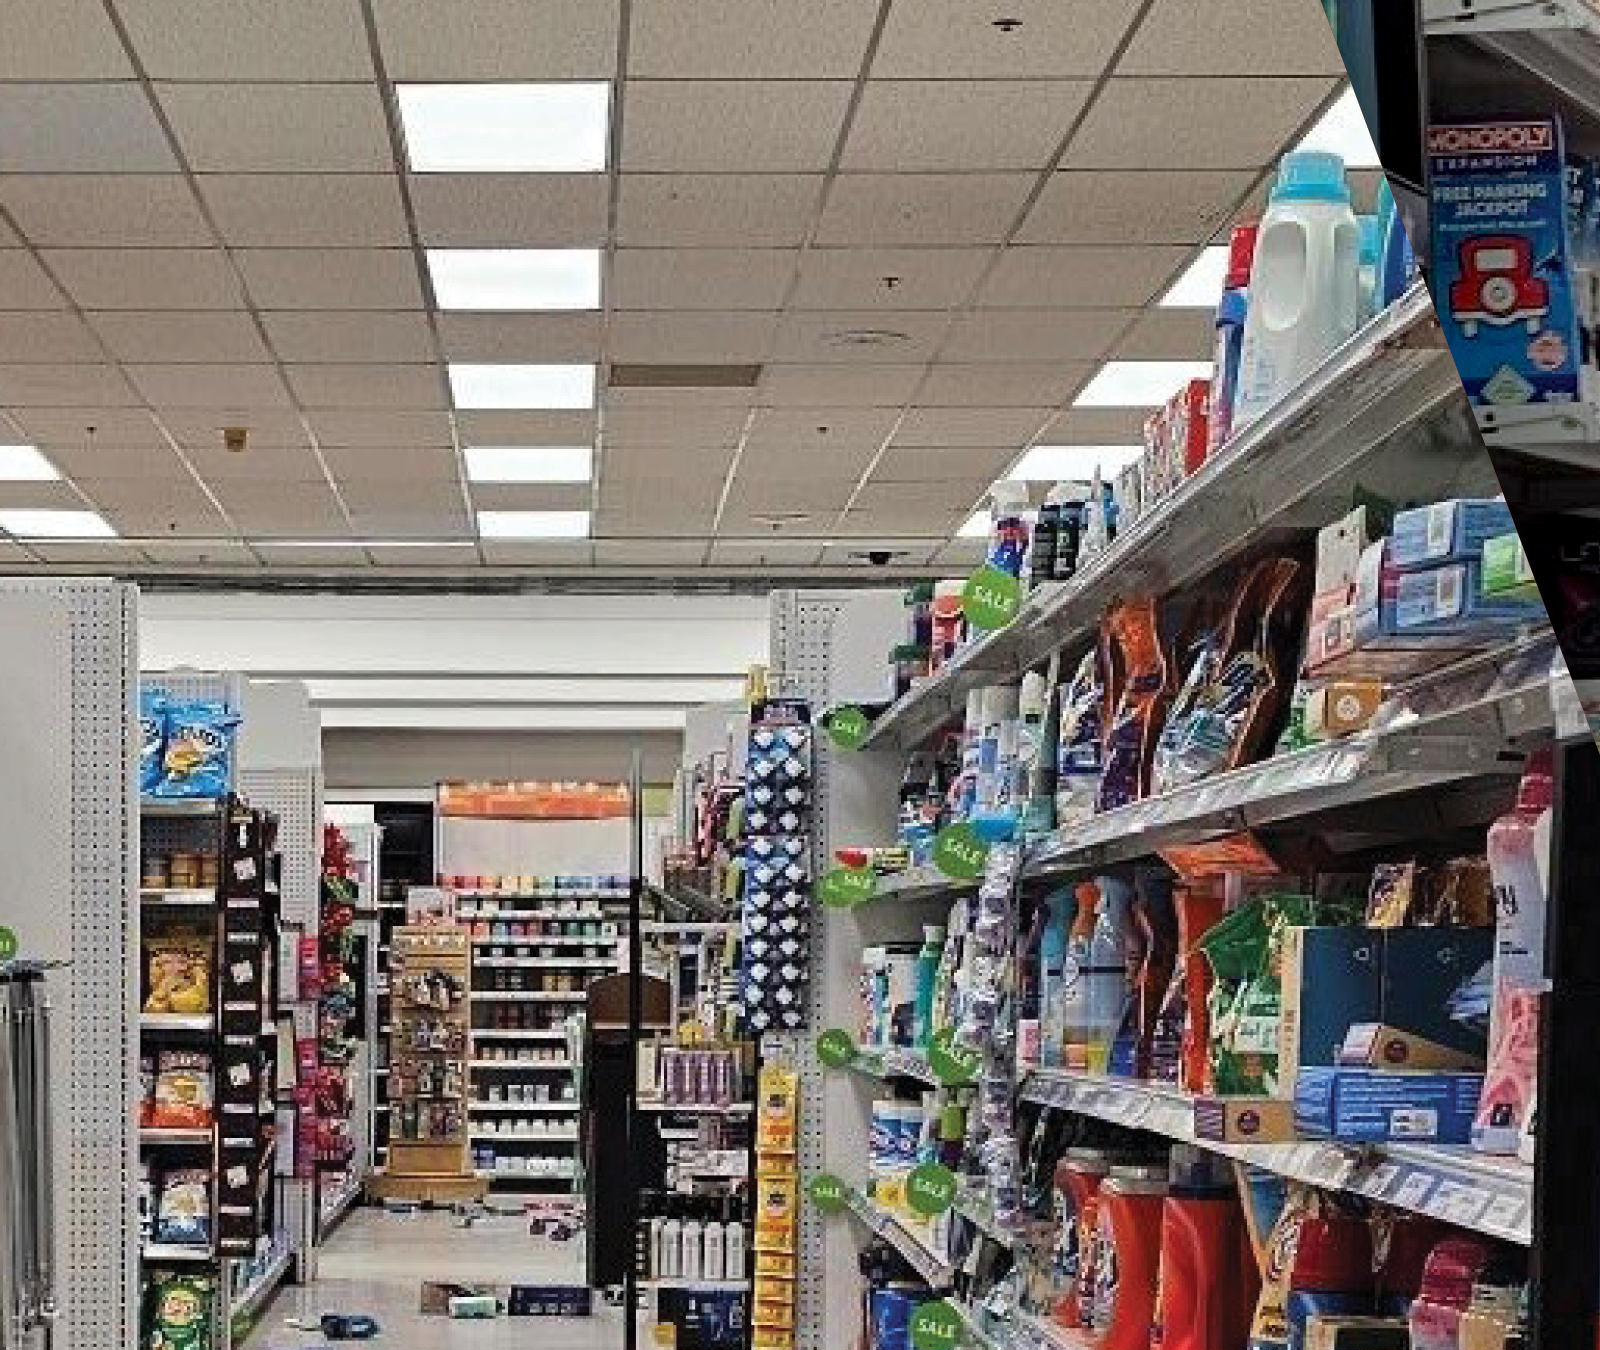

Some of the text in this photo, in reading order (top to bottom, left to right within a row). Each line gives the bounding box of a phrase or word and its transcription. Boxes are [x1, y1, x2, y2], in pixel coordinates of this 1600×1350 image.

[1427, 127, 1549, 149] MONOPOLY
[1433, 183, 1547, 202] FREE PARKING
[1455, 200, 1528, 216] JACKPOT
[974, 584, 1013, 609] SALE
[944, 838, 984, 868] SALE
[914, 1179, 949, 1198] SALE
[918, 1318, 956, 1338] SALE
